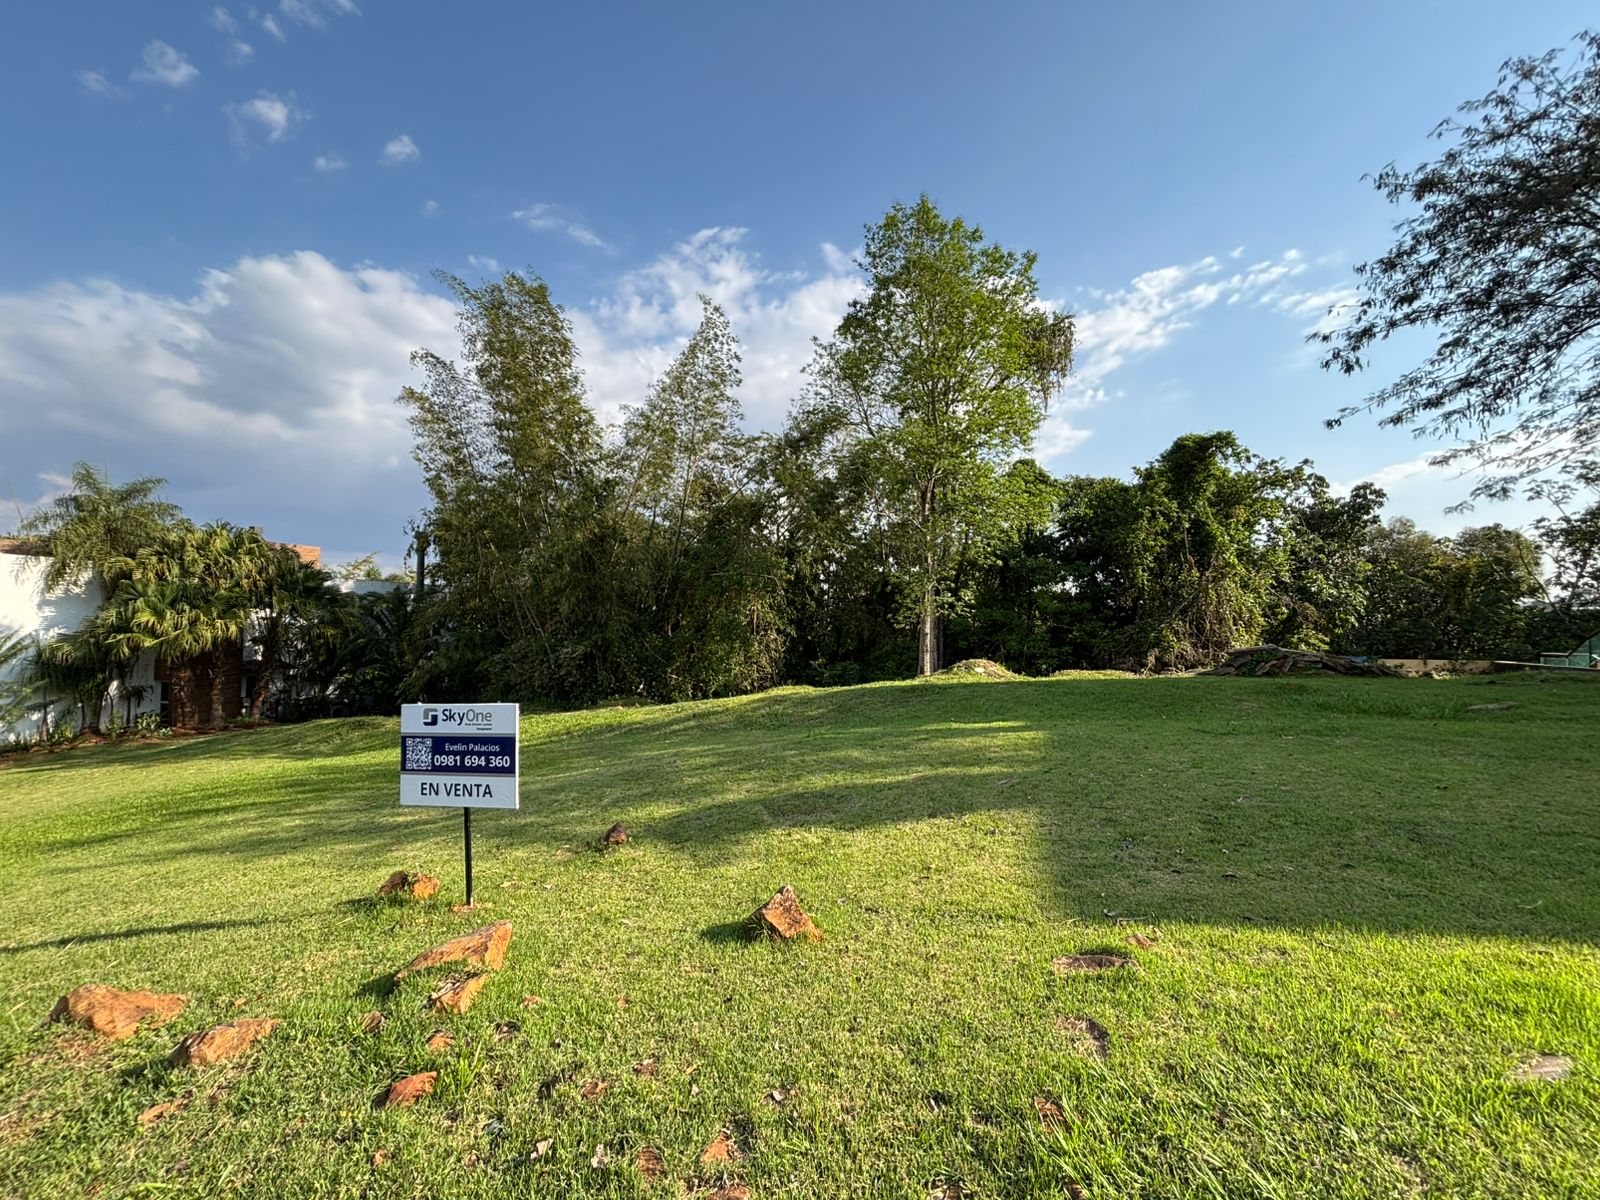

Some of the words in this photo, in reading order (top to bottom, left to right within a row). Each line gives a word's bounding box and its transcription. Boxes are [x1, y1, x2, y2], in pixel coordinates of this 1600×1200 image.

[441, 708, 492, 726] SkyOne
[445, 743, 467, 752] Evelin
[468, 743, 500, 752] Palacios
[433, 755, 460, 766] 0981
[464, 755, 486, 767] 694
[488, 756, 510, 767] 360
[420, 782, 439, 796] EN
[444, 783, 493, 798] VENTA
